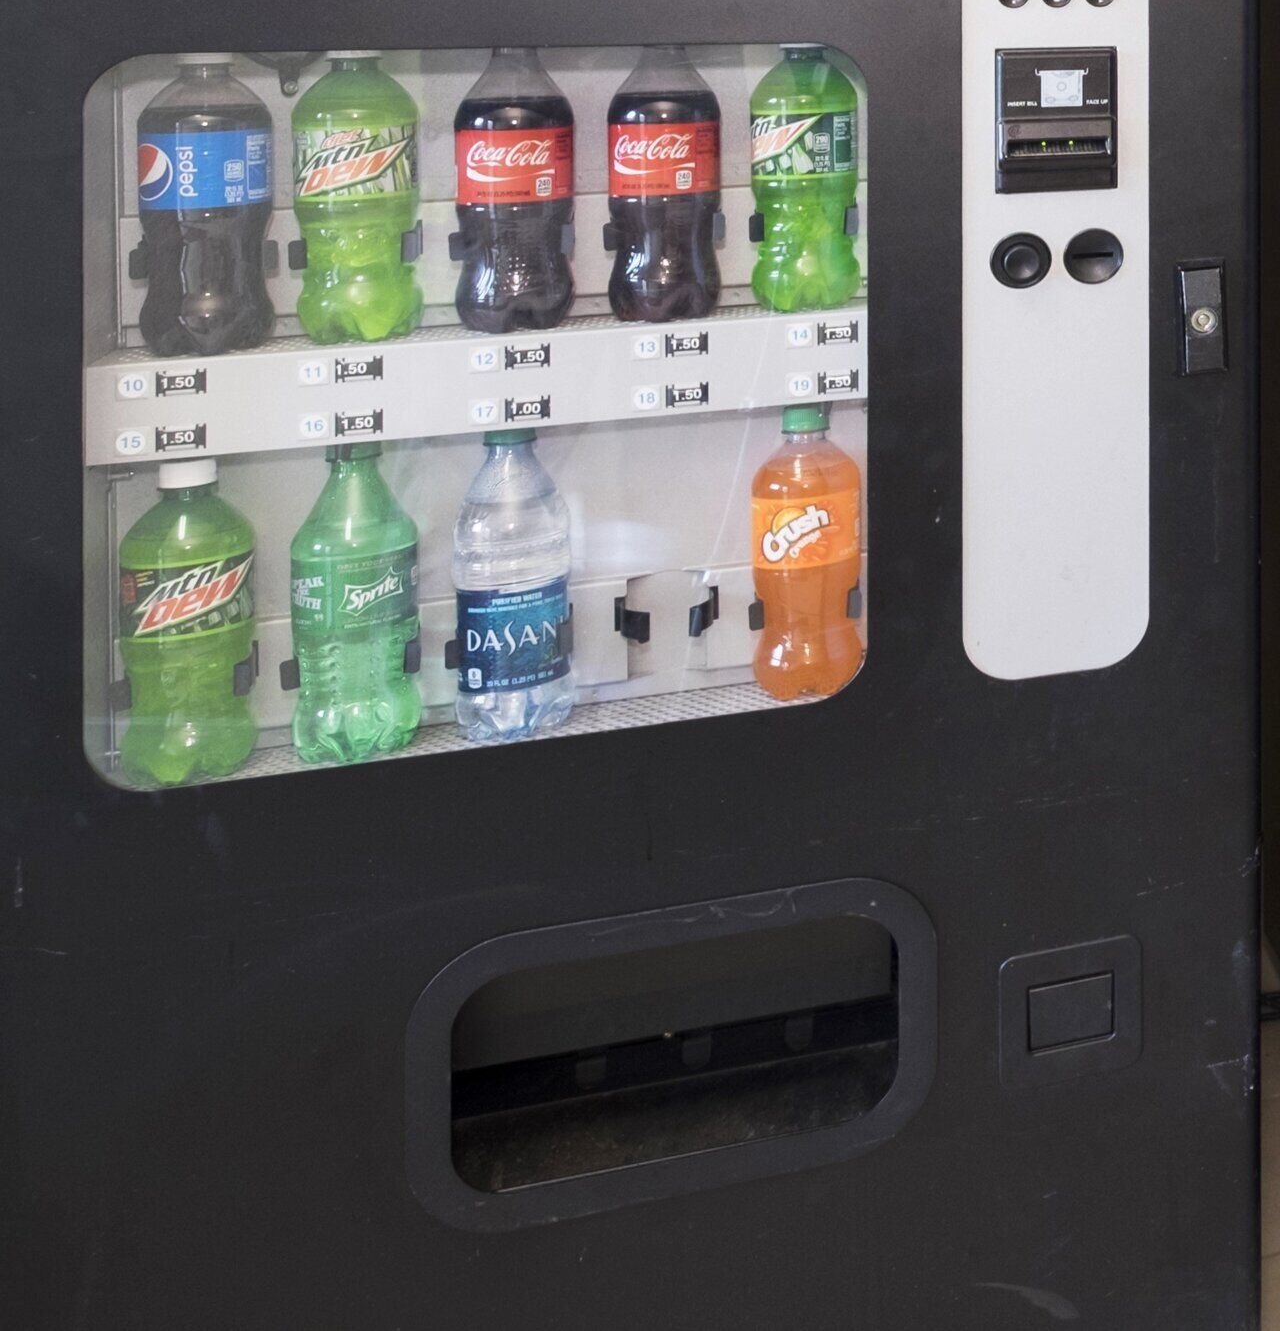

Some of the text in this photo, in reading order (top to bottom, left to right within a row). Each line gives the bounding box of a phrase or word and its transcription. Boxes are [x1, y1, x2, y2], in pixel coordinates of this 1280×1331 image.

[466, 140, 553, 167] Coca-Cola
[614, 133, 692, 160] Coca-Cola
[176, 146, 198, 197] pepsi
[537, 178, 551, 188] 240
[791, 327, 852, 341] 14 1.50
[638, 337, 699, 353] 13 1.50
[475, 349, 545, 366] 12 1.50
[304, 362, 367, 379] 11 1.50
[123, 375, 195, 393] 10 1.50
[793, 375, 851, 392] 19 1.50
[638, 387, 702, 405] 18 1.50
[475, 402, 541, 419] 17 1.00
[304, 416, 374, 433] 16 1.50
[121, 431, 195, 449] 15 1.50
[762, 505, 830, 562] Crush
[346, 575, 399, 610] Sprite
[491, 595, 522, 606] PURIFIED
[523, 591, 543, 602] WATER
[466, 616, 563, 657] DASAN
